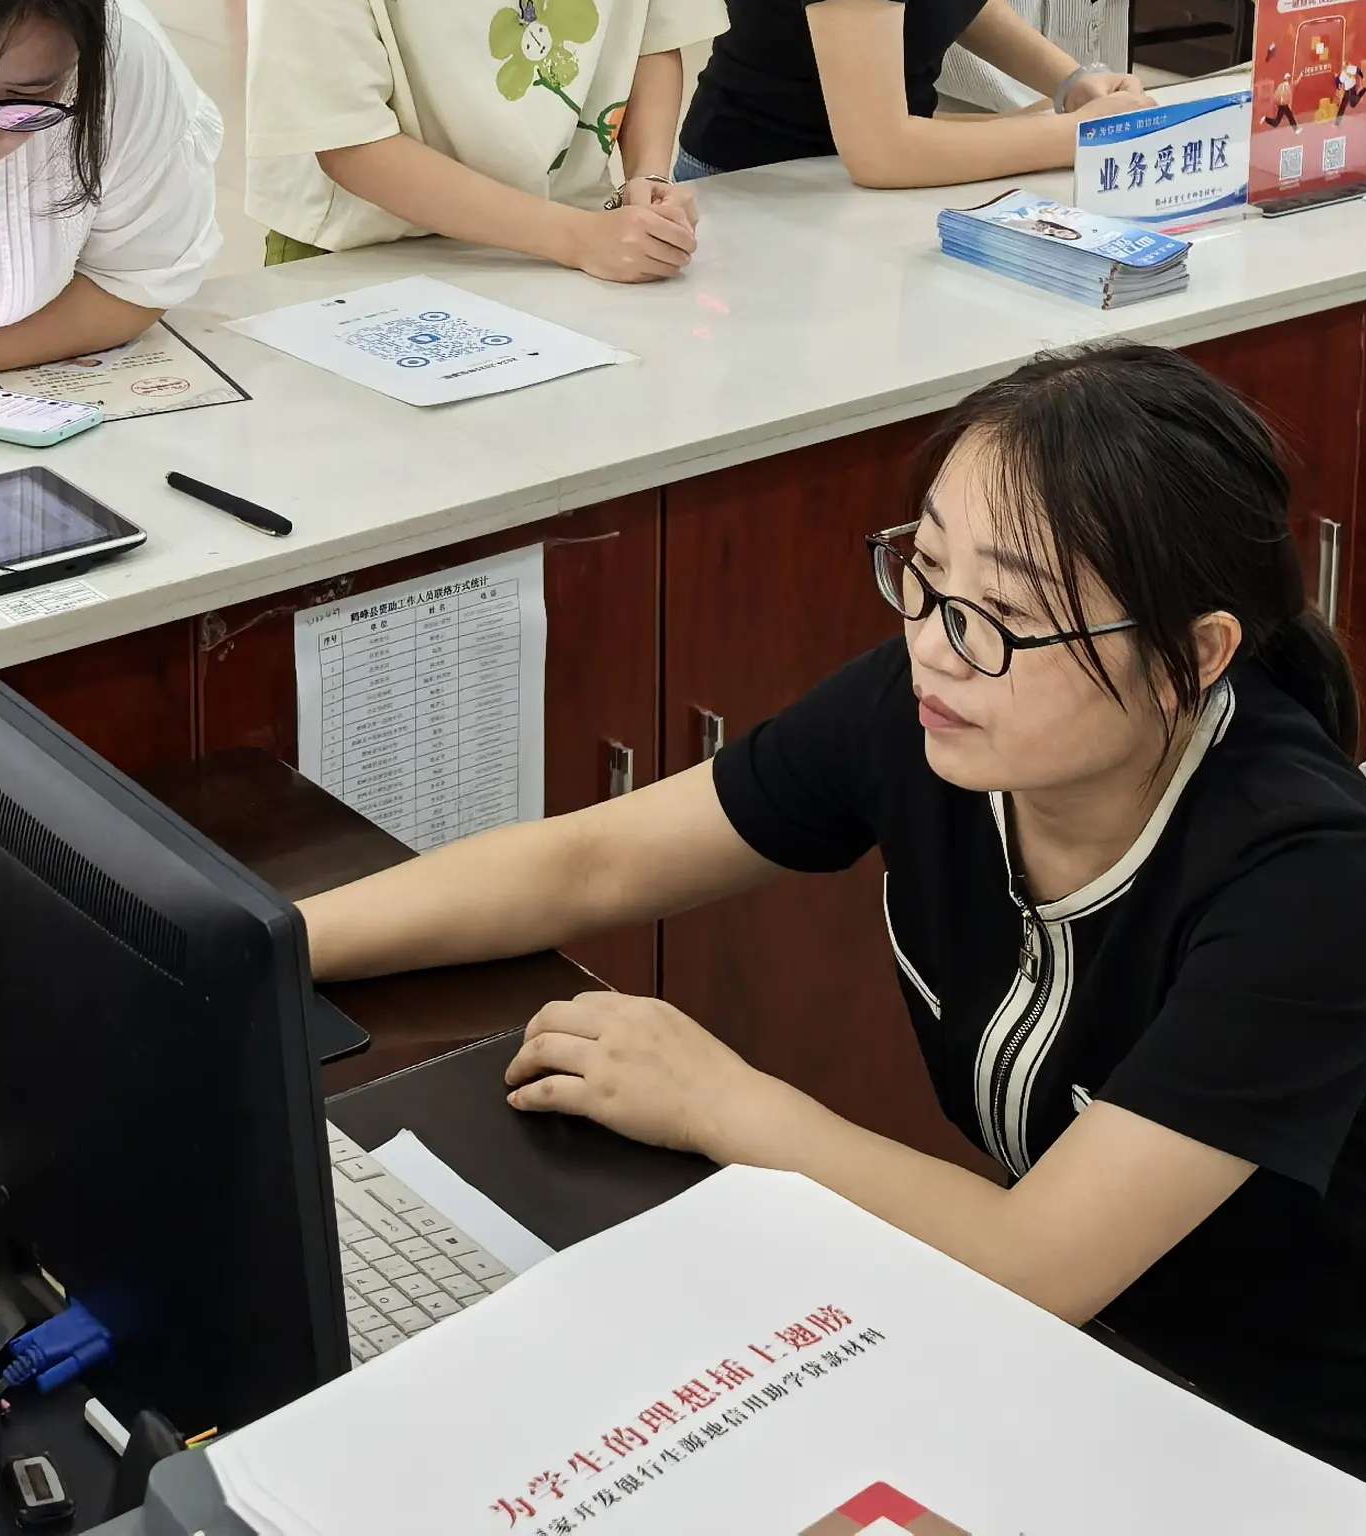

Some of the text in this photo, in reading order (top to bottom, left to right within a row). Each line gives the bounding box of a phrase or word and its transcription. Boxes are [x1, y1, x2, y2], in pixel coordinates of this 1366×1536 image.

[1097, 133, 1231, 194] 业务受理区
[349, 575, 490, 623] 鹤峰县资助工作人员联络方式统计
[488, 1302, 854, 1530] 为学生的理想插上翅膀
